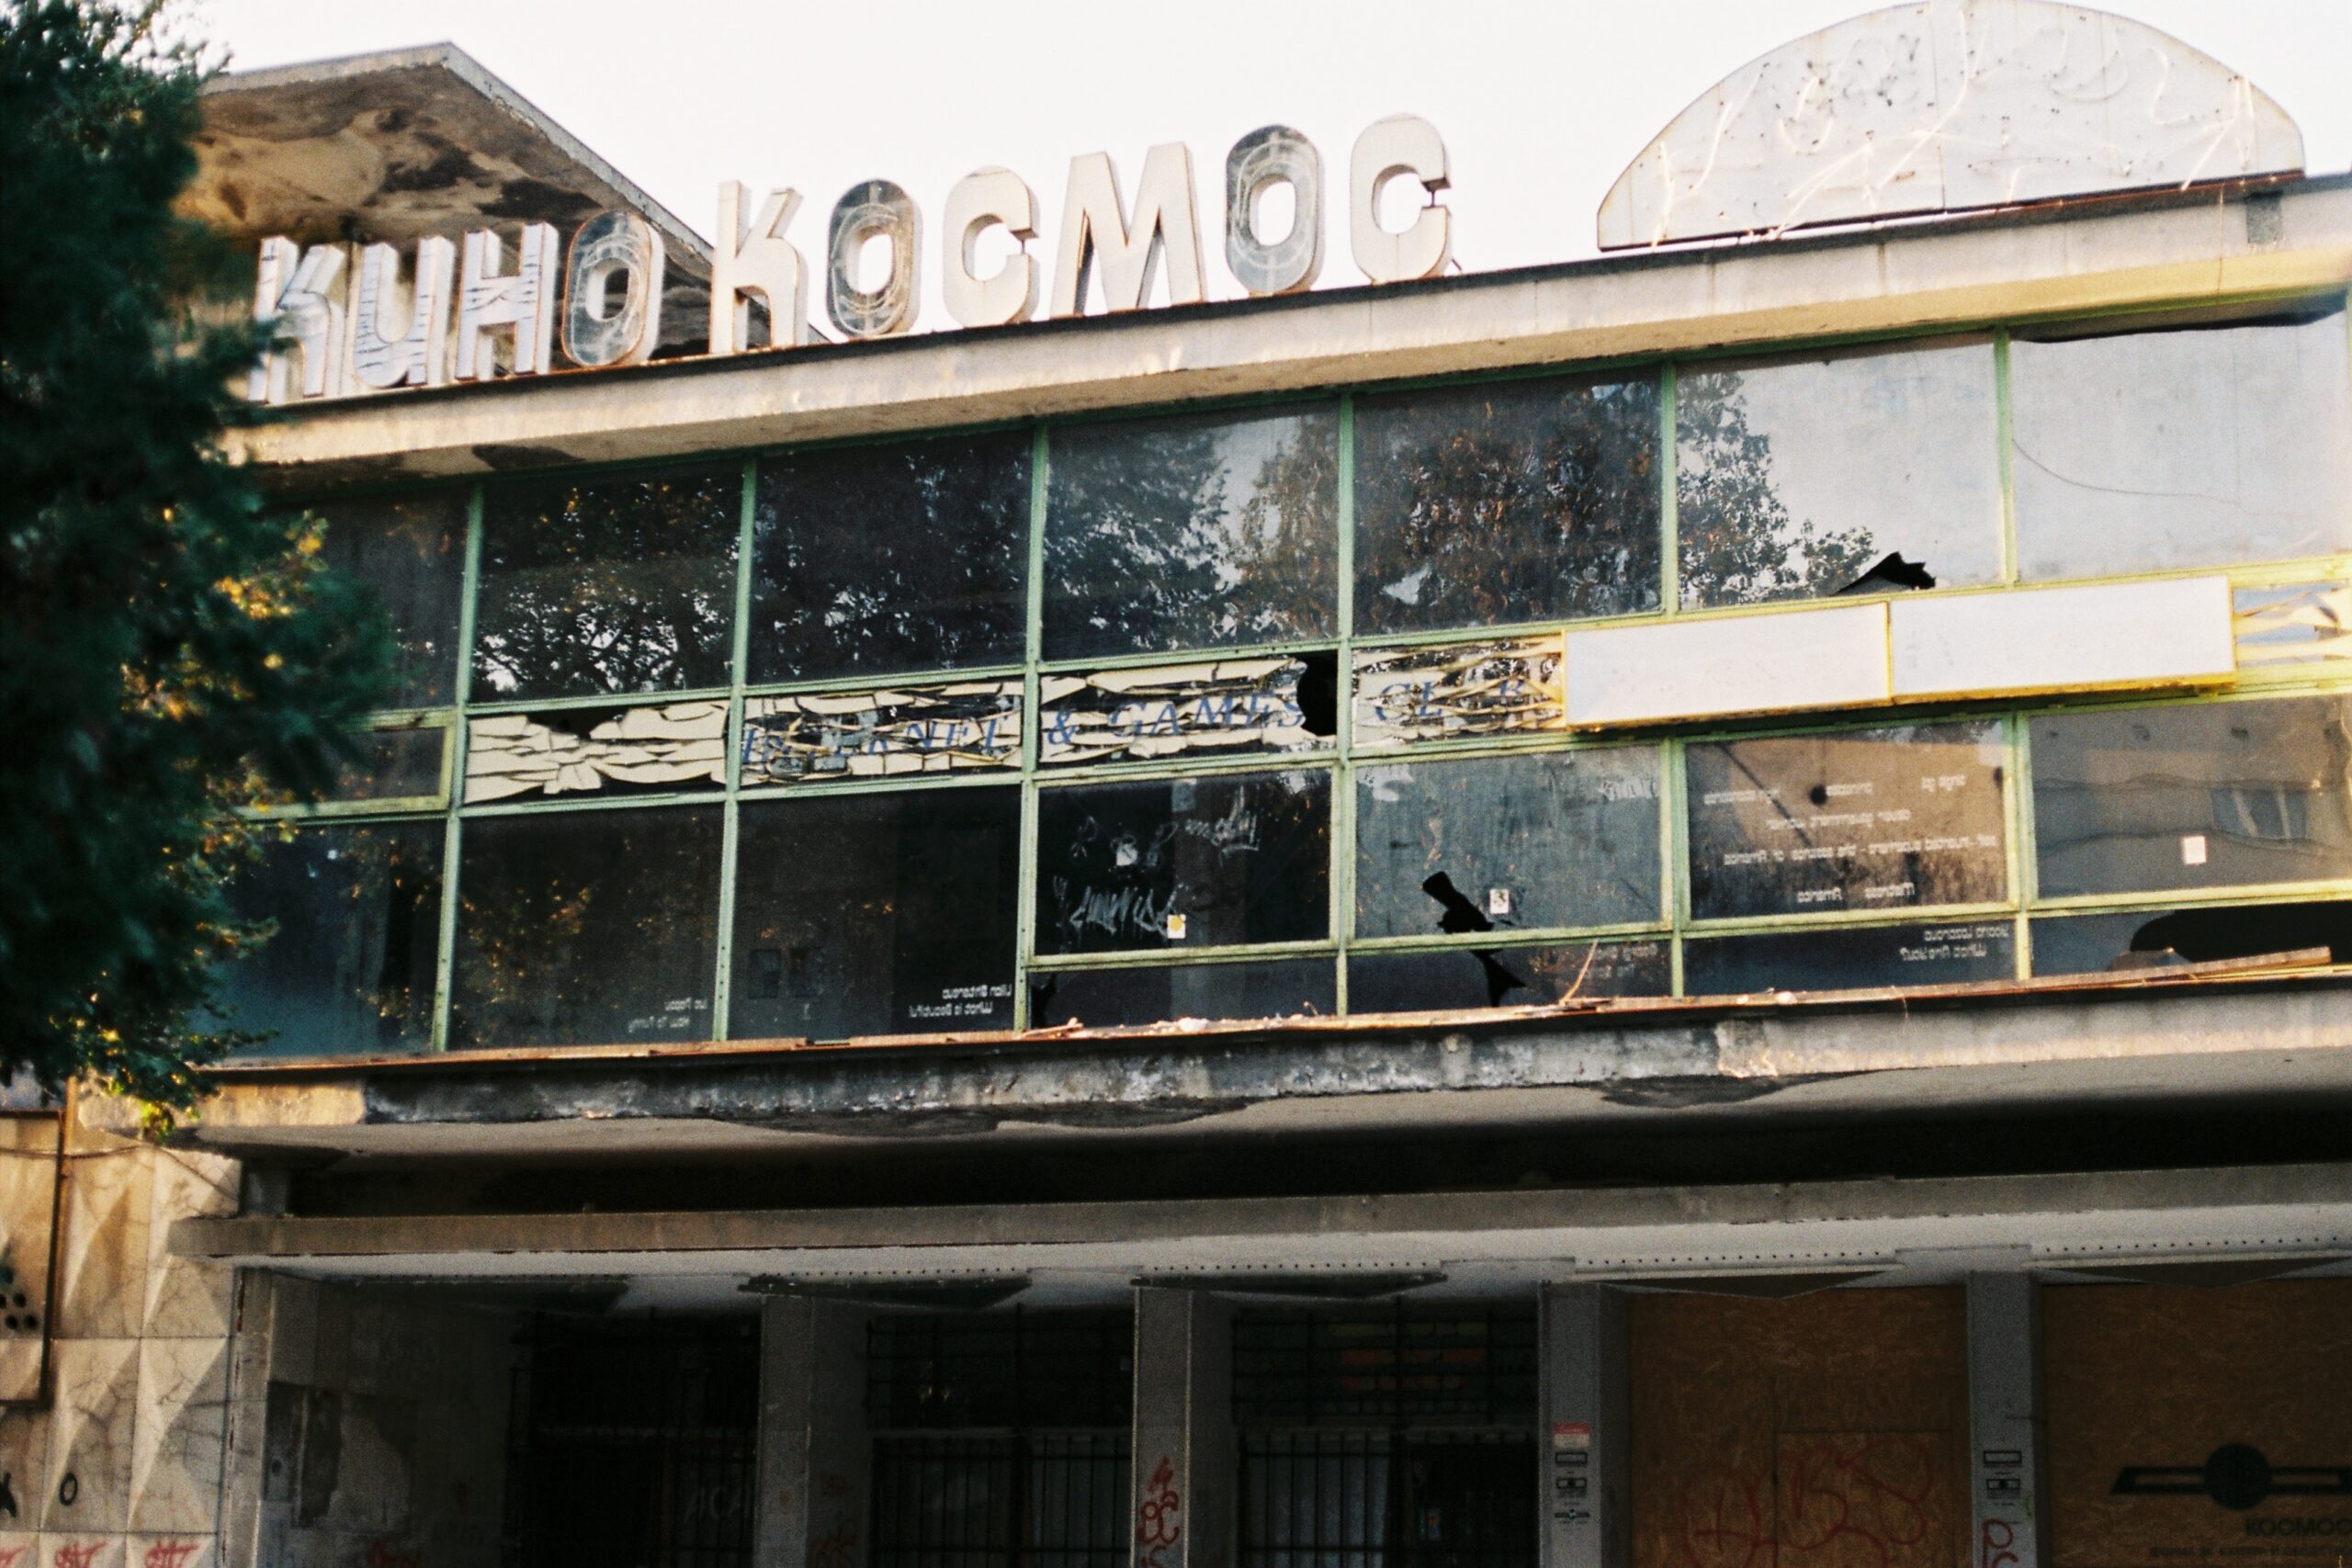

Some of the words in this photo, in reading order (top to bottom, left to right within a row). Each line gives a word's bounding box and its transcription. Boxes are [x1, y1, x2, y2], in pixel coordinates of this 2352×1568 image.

[248, 209, 662, 403] КИНО
[709, 113, 1453, 354] КОСМОС
[1046, 708, 1081, 746] &
